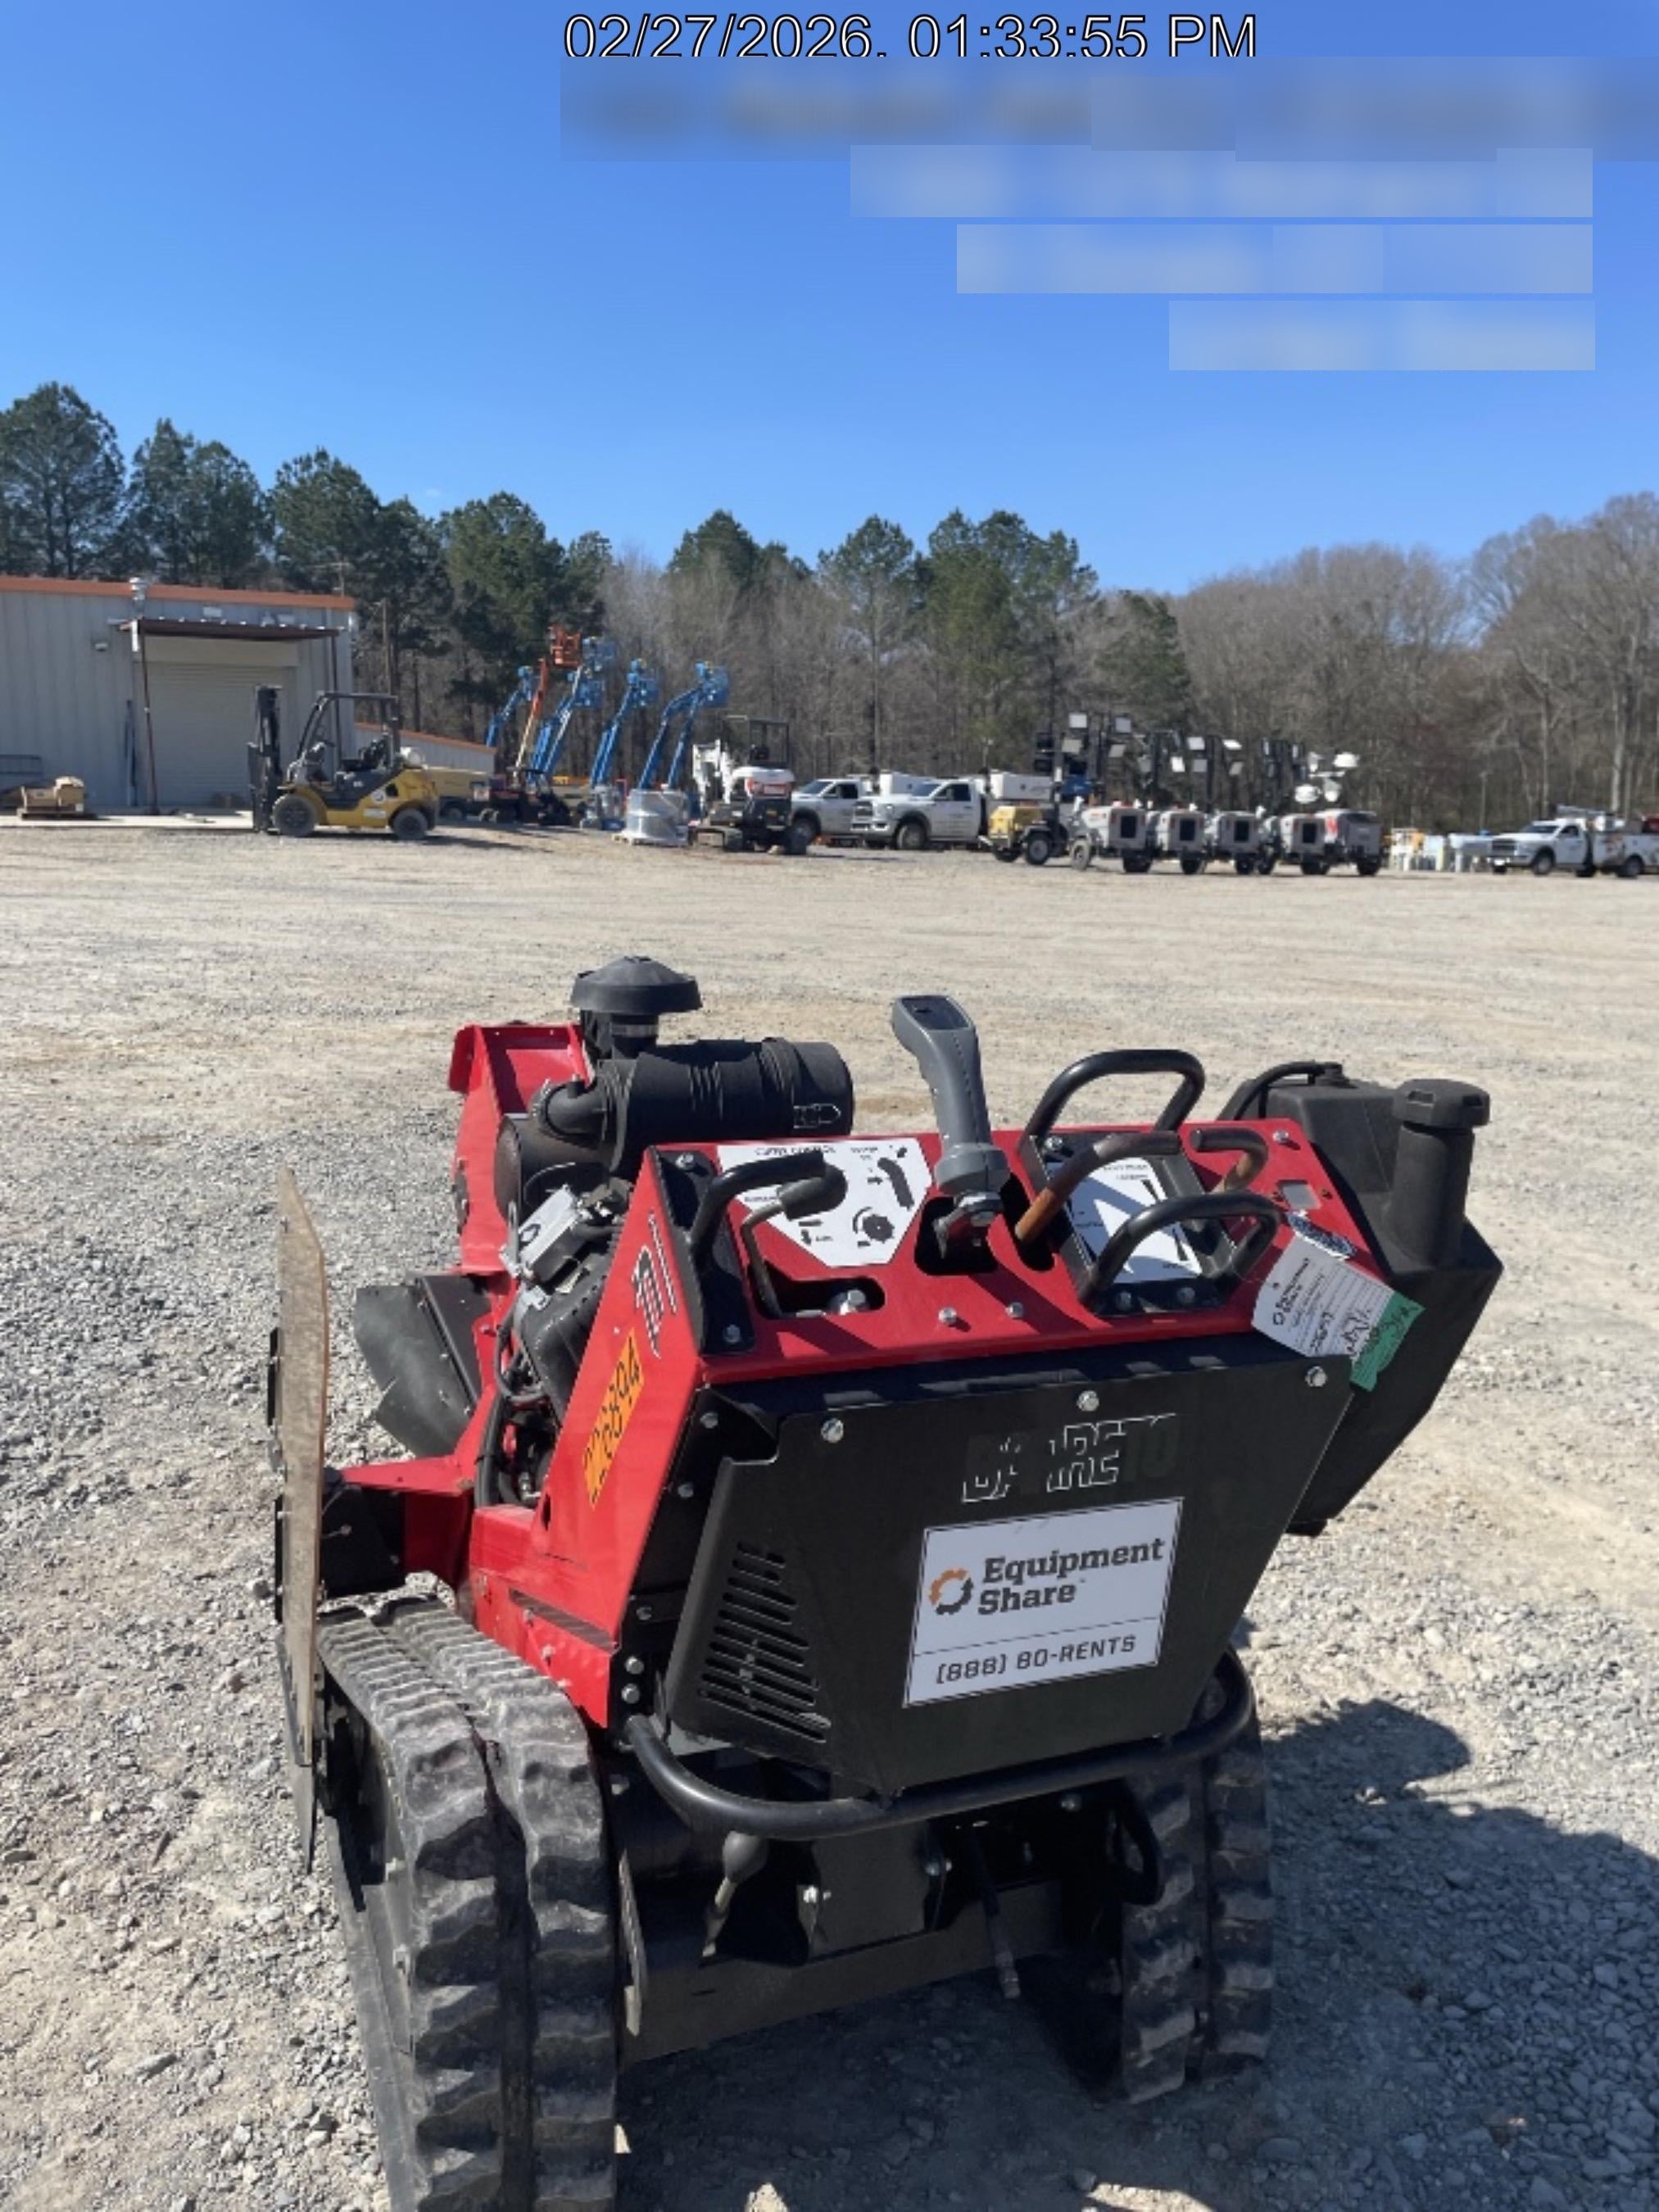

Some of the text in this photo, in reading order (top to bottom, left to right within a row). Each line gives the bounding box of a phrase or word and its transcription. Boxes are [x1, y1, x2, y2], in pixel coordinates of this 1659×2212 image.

[983, 1538, 1165, 1585] Equipment
[977, 1584, 1077, 1615] Share
[936, 1634, 1135, 1684] (888) 80-RENTS
